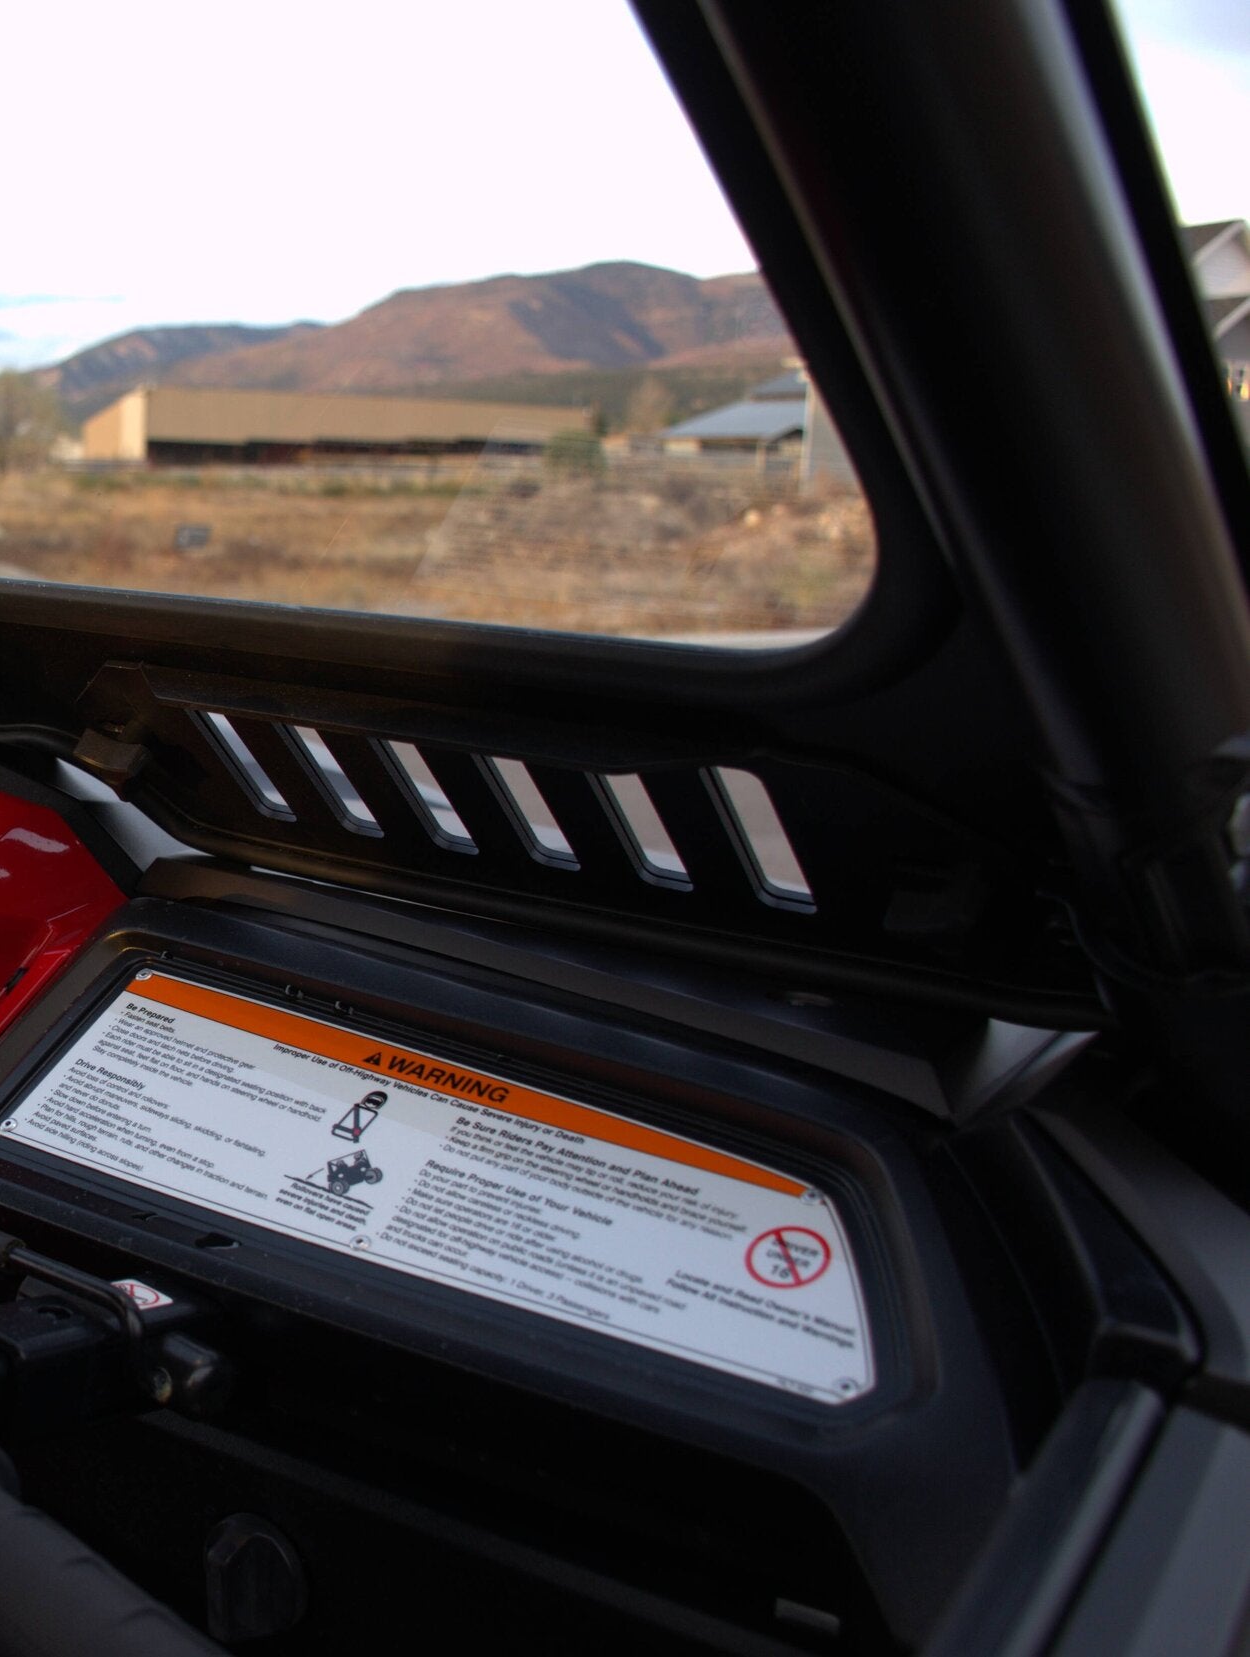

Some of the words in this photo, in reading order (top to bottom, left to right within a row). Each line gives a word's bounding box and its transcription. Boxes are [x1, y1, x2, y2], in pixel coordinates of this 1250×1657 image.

[126, 1003, 138, 1011] Be
[138, 1007, 175, 1024] Prepared
[75, 1058, 96, 1071] Drive
[96, 1067, 145, 1090] Responsibly
[273, 1044, 311, 1059] Improper
[311, 1056, 328, 1065] Use
[339, 1065, 391, 1086] Off-Highway
[393, 1082, 429, 1097] Vehicles
[430, 1093, 449, 1103] Can
[450, 1100, 479, 1113] Cause
[480, 1109, 513, 1123] Severe
[514, 1119, 541, 1132] Injury
[555, 1131, 585, 1144] Death
[387, 1055, 510, 1103] WARNING
[456, 1117, 471, 1126] Be
[472, 1122, 497, 1134] Sure
[498, 1130, 533, 1145] Riders
[535, 1141, 555, 1153] Pay
[556, 1148, 606, 1168] Attention
[608, 1164, 631, 1175] and
[632, 1170, 659, 1183] Plan
[661, 1179, 699, 1196] Ahead
[425, 1160, 466, 1178] Require
[467, 1173, 504, 1190] Proper
[505, 1186, 527, 1198] Use
[545, 1198, 570, 1211] Your
[573, 1207, 613, 1226] Vehicle
